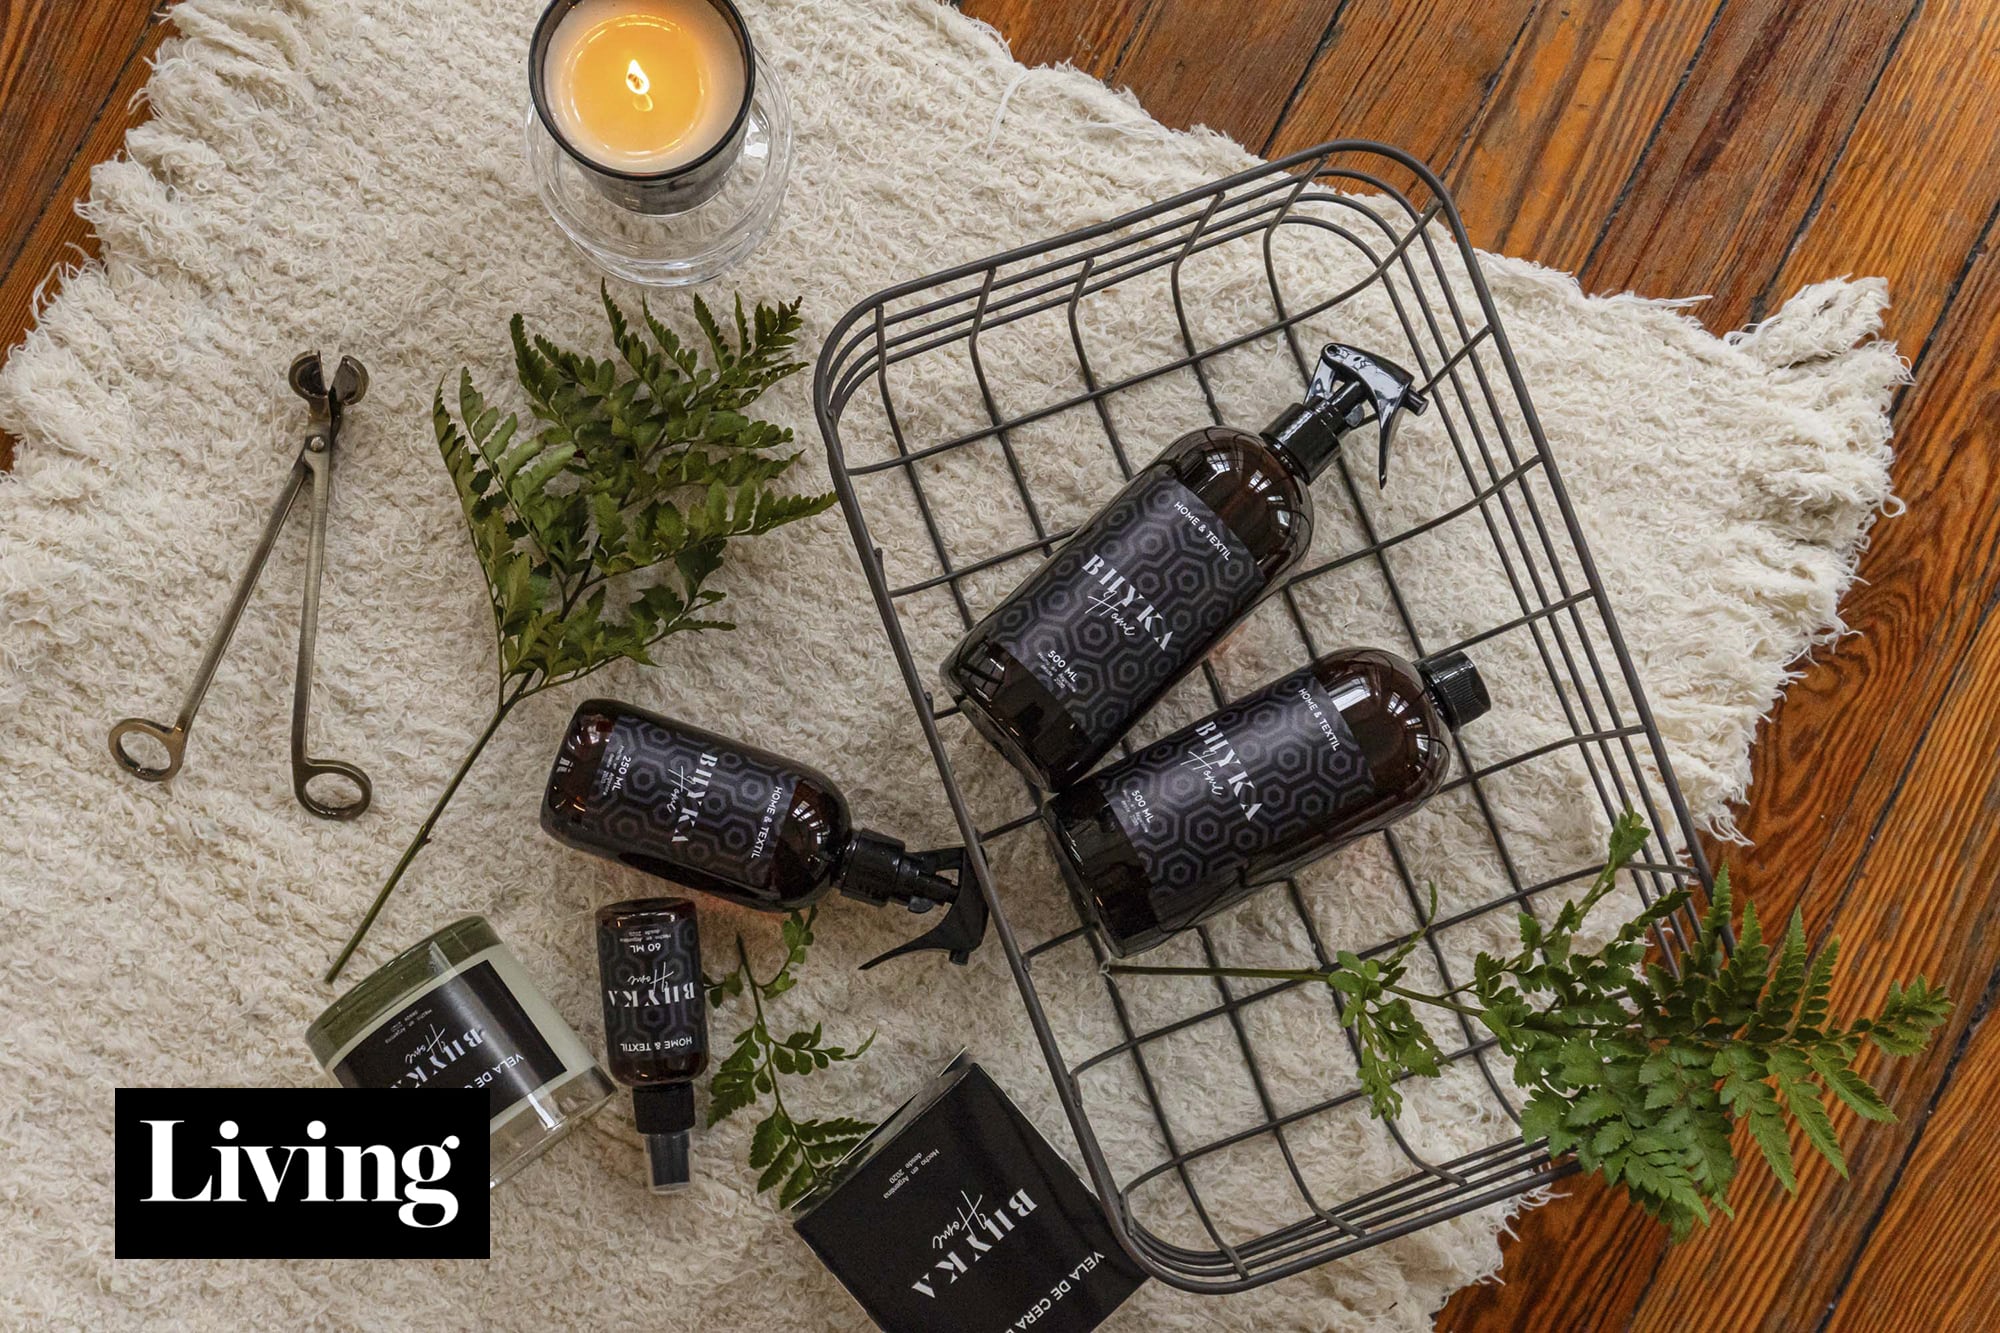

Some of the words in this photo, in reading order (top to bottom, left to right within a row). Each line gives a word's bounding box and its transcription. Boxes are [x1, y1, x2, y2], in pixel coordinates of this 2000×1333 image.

[1173, 501, 1199, 526] HOME
[1198, 524, 1206, 533] &
[1206, 530, 1232, 561] TEXTIL
[1084, 590, 1135, 636] Home
[1048, 650, 1066, 668] 500
[1064, 667, 1077, 682] ML
[1298, 688, 1316, 711] HOME
[1313, 710, 1321, 719] &
[1319, 718, 1343, 751] TEXTIL
[618, 755, 632, 775] 250
[1180, 749, 1224, 796] Home
[611, 776, 624, 791] ML
[666, 765, 697, 813] Home
[766, 786, 783, 816] HOME
[1131, 790, 1146, 807] 500
[1142, 808, 1154, 823] ML
[762, 815, 773, 823] &
[750, 825, 770, 859] TEXTIL
[629, 945, 644, 953] ML
[648, 942, 661, 951] 60
[627, 961, 674, 992] Home
[405, 1023, 445, 1064] Home
[620, 1042, 652, 1052] TEXTIL
[654, 1042, 662, 1050] &
[664, 1036, 692, 1049] HOME
[492, 1053, 524, 1073] VELA
[474, 1071, 493, 1088] DE
[905, 1152, 922, 1169] desde
[920, 1149, 940, 1166] Hecho
[889, 1168, 905, 1184] 2020
[910, 1166, 919, 1175] en
[883, 1176, 910, 1199] Argentina
[932, 1190, 988, 1250] Home
[1068, 1251, 1105, 1281] VELA
[1050, 1280, 1072, 1301] DE
[1014, 1298, 1052, 1330] CERA
